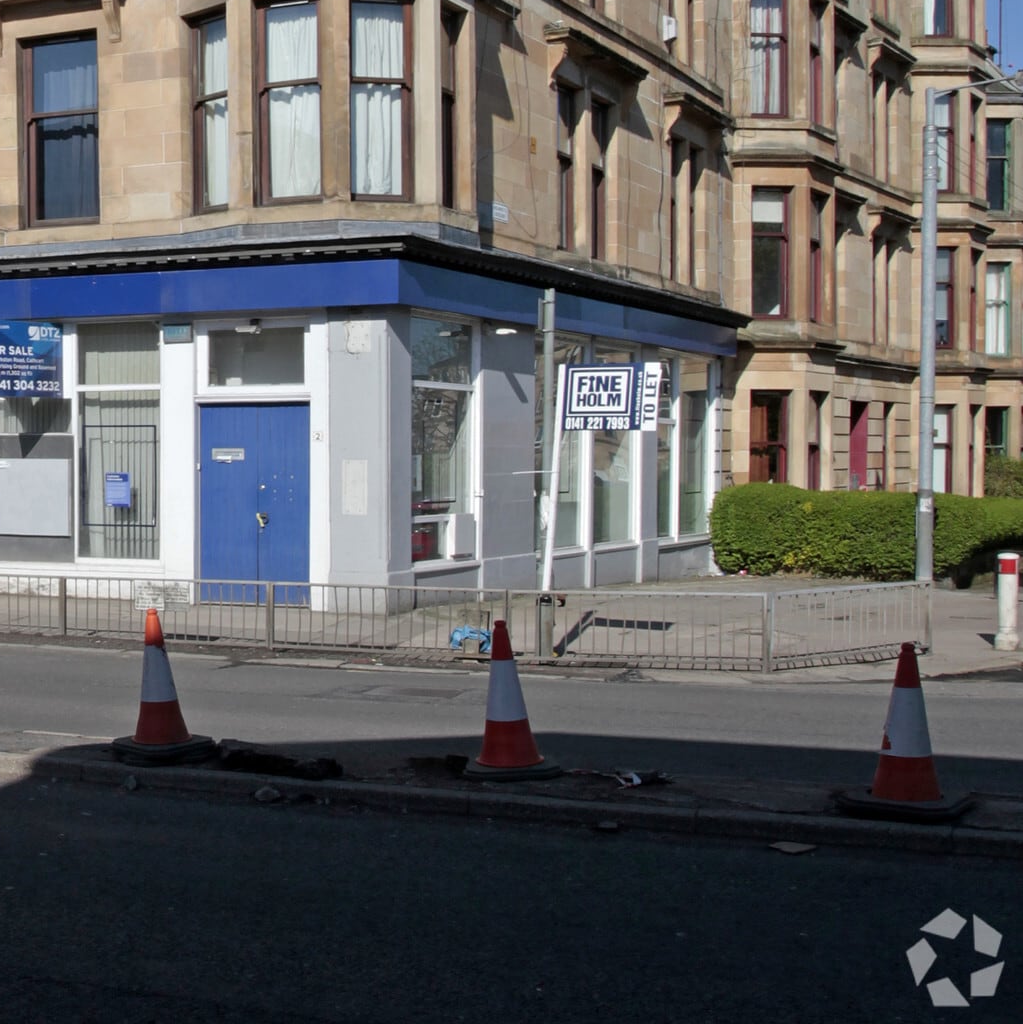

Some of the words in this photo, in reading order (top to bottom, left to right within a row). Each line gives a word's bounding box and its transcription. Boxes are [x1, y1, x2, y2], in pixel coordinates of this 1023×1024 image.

[40, 326, 61, 338] DTZ
[8, 345, 34, 356] SALE
[13, 380, 35, 391] 304
[36, 380, 61, 391] 3232
[577, 375, 622, 392] FINE
[644, 371, 658, 397] LET
[576, 393, 622, 407] HOLM
[642, 403, 656, 423] TO
[564, 416, 585, 430] 0141
[587, 416, 604, 430] 221
[606, 416, 631, 430] 7993
